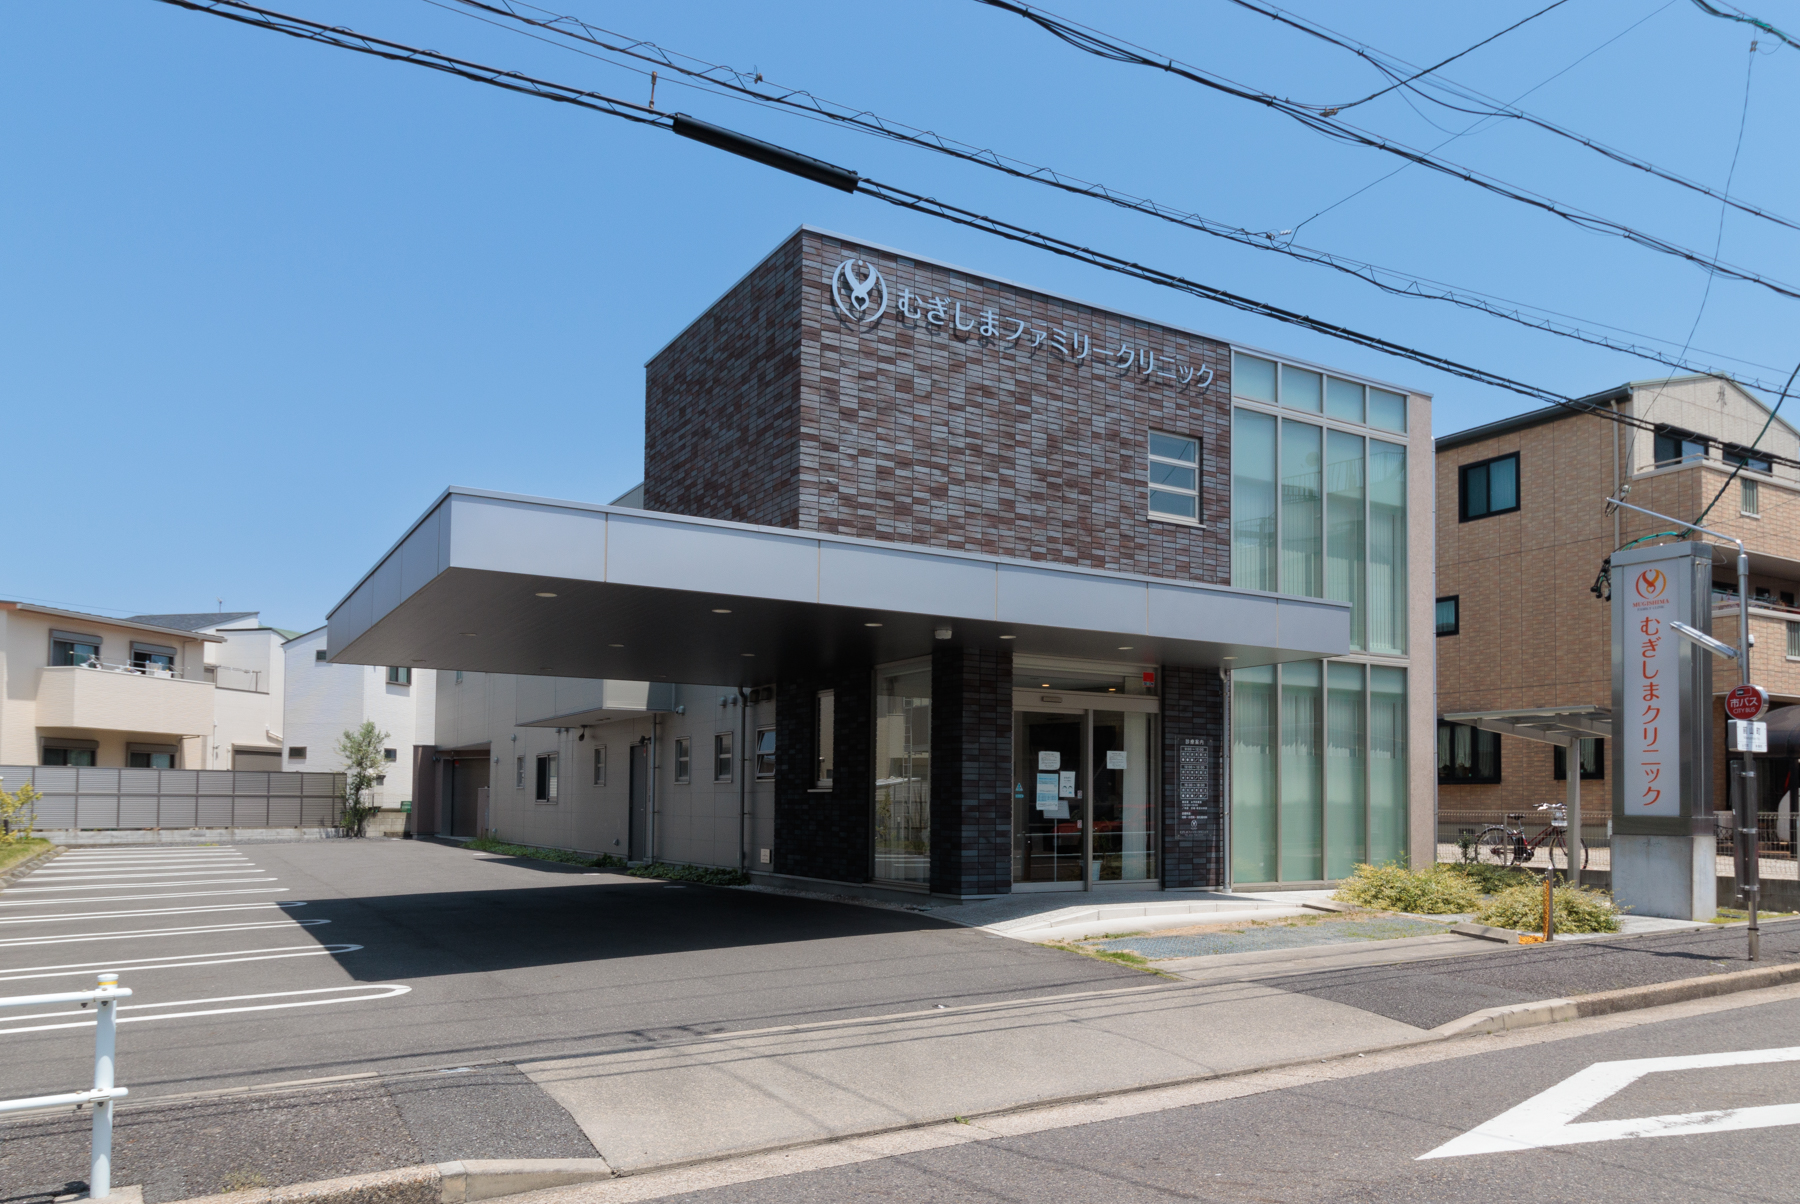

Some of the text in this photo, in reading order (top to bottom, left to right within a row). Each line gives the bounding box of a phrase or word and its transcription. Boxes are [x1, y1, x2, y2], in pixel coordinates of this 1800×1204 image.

[897, 287, 1214, 389] むぎしまファミリークリニック
[1632, 598, 1670, 608] MUGISHIMA
[1640, 615, 1662, 807] むぎしまクリニック
[1730, 697, 1758, 708] 市バス
